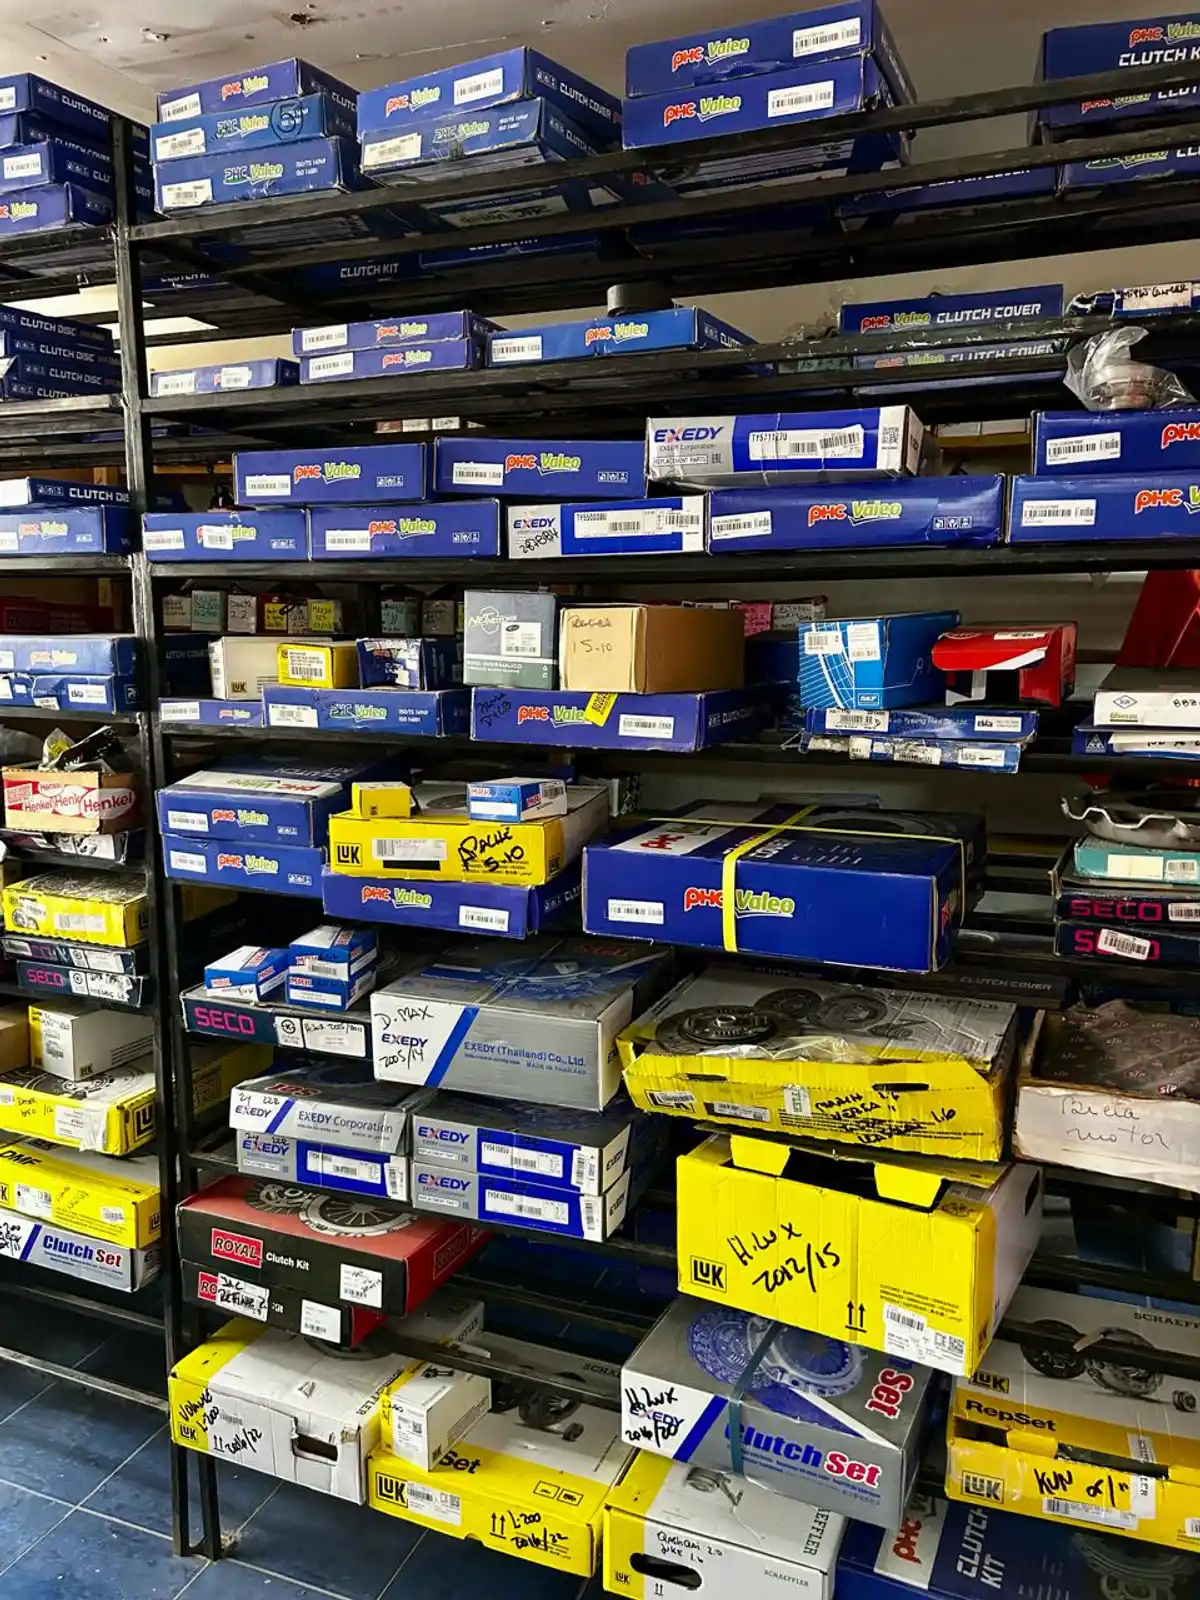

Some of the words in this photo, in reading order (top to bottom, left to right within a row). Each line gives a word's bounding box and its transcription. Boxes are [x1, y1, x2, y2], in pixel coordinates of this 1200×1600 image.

[707, 37, 750, 64] Valeo
[1119, 48, 1187, 67] CLUTCH
[62, 95, 92, 115] CLUTCH
[560, 83, 588, 107] CLUTCH
[588, 99, 612, 119] COVER
[700, 95, 741, 122] Valeo
[250, 163, 284, 183] Valeo
[341, 266, 380, 279] CLUTCH
[382, 263, 399, 275] KIT
[20, 316, 56, 332] CLUTCH
[57, 324, 77, 337] DISC
[894, 312, 932, 331] Valeo
[936, 308, 993, 324] CLUTCH
[993, 303, 1042, 319] COVER
[614, 322, 649, 342] Valeo
[40, 344, 74, 358] CLUTCH
[76, 351, 95, 363] DISC
[49, 367, 83, 382] CLUTCH
[83, 374, 102, 386] DISC
[654, 426, 724, 444] EXEDY
[324, 462, 361, 481] Valeo
[540, 453, 581, 474] Valeo
[69, 487, 113, 501] CLUTCH
[852, 501, 902, 523] Valeo
[398, 518, 436, 537] Valeo
[513, 518, 556, 529] EXEDY
[354, 704, 387, 719] Valeo
[553, 706, 586, 724] Vale
[84, 792, 133, 812] Henkel
[238, 811, 269, 826] Valeo
[245, 855, 279, 874] Valeo
[393, 887, 432, 907] Valeo
[736, 890, 796, 916] Valeo
[1070, 900, 1163, 921] SECO
[27, 969, 64, 988] SECO
[194, 1007, 255, 1035] SECO
[381, 1034, 428, 1047] EXEDY
[464, 1041, 496, 1053] EXEDY
[497, 1045, 548, 1062] (Thailand)
[235, 1105, 271, 1118] EXEDY
[299, 1110, 332, 1124] EXEDY
[333, 1116, 393, 1133] Corporation
[418, 1126, 470, 1144] EXEDY
[1, 1150, 42, 1165] DMF
[243, 1140, 290, 1156] EXEDY
[418, 1173, 471, 1191] EXEDY
[43, 1235, 94, 1260] Clutch
[95, 1249, 122, 1267] Set
[214, 1238, 260, 1259] ROYAL
[266, 1252, 294, 1268] Clutch
[296, 1259, 310, 1271] Kit
[965, 1399, 1057, 1432] RepSet
[826, 1451, 882, 1489] Set
[980, 1552, 1006, 1589] KIT
